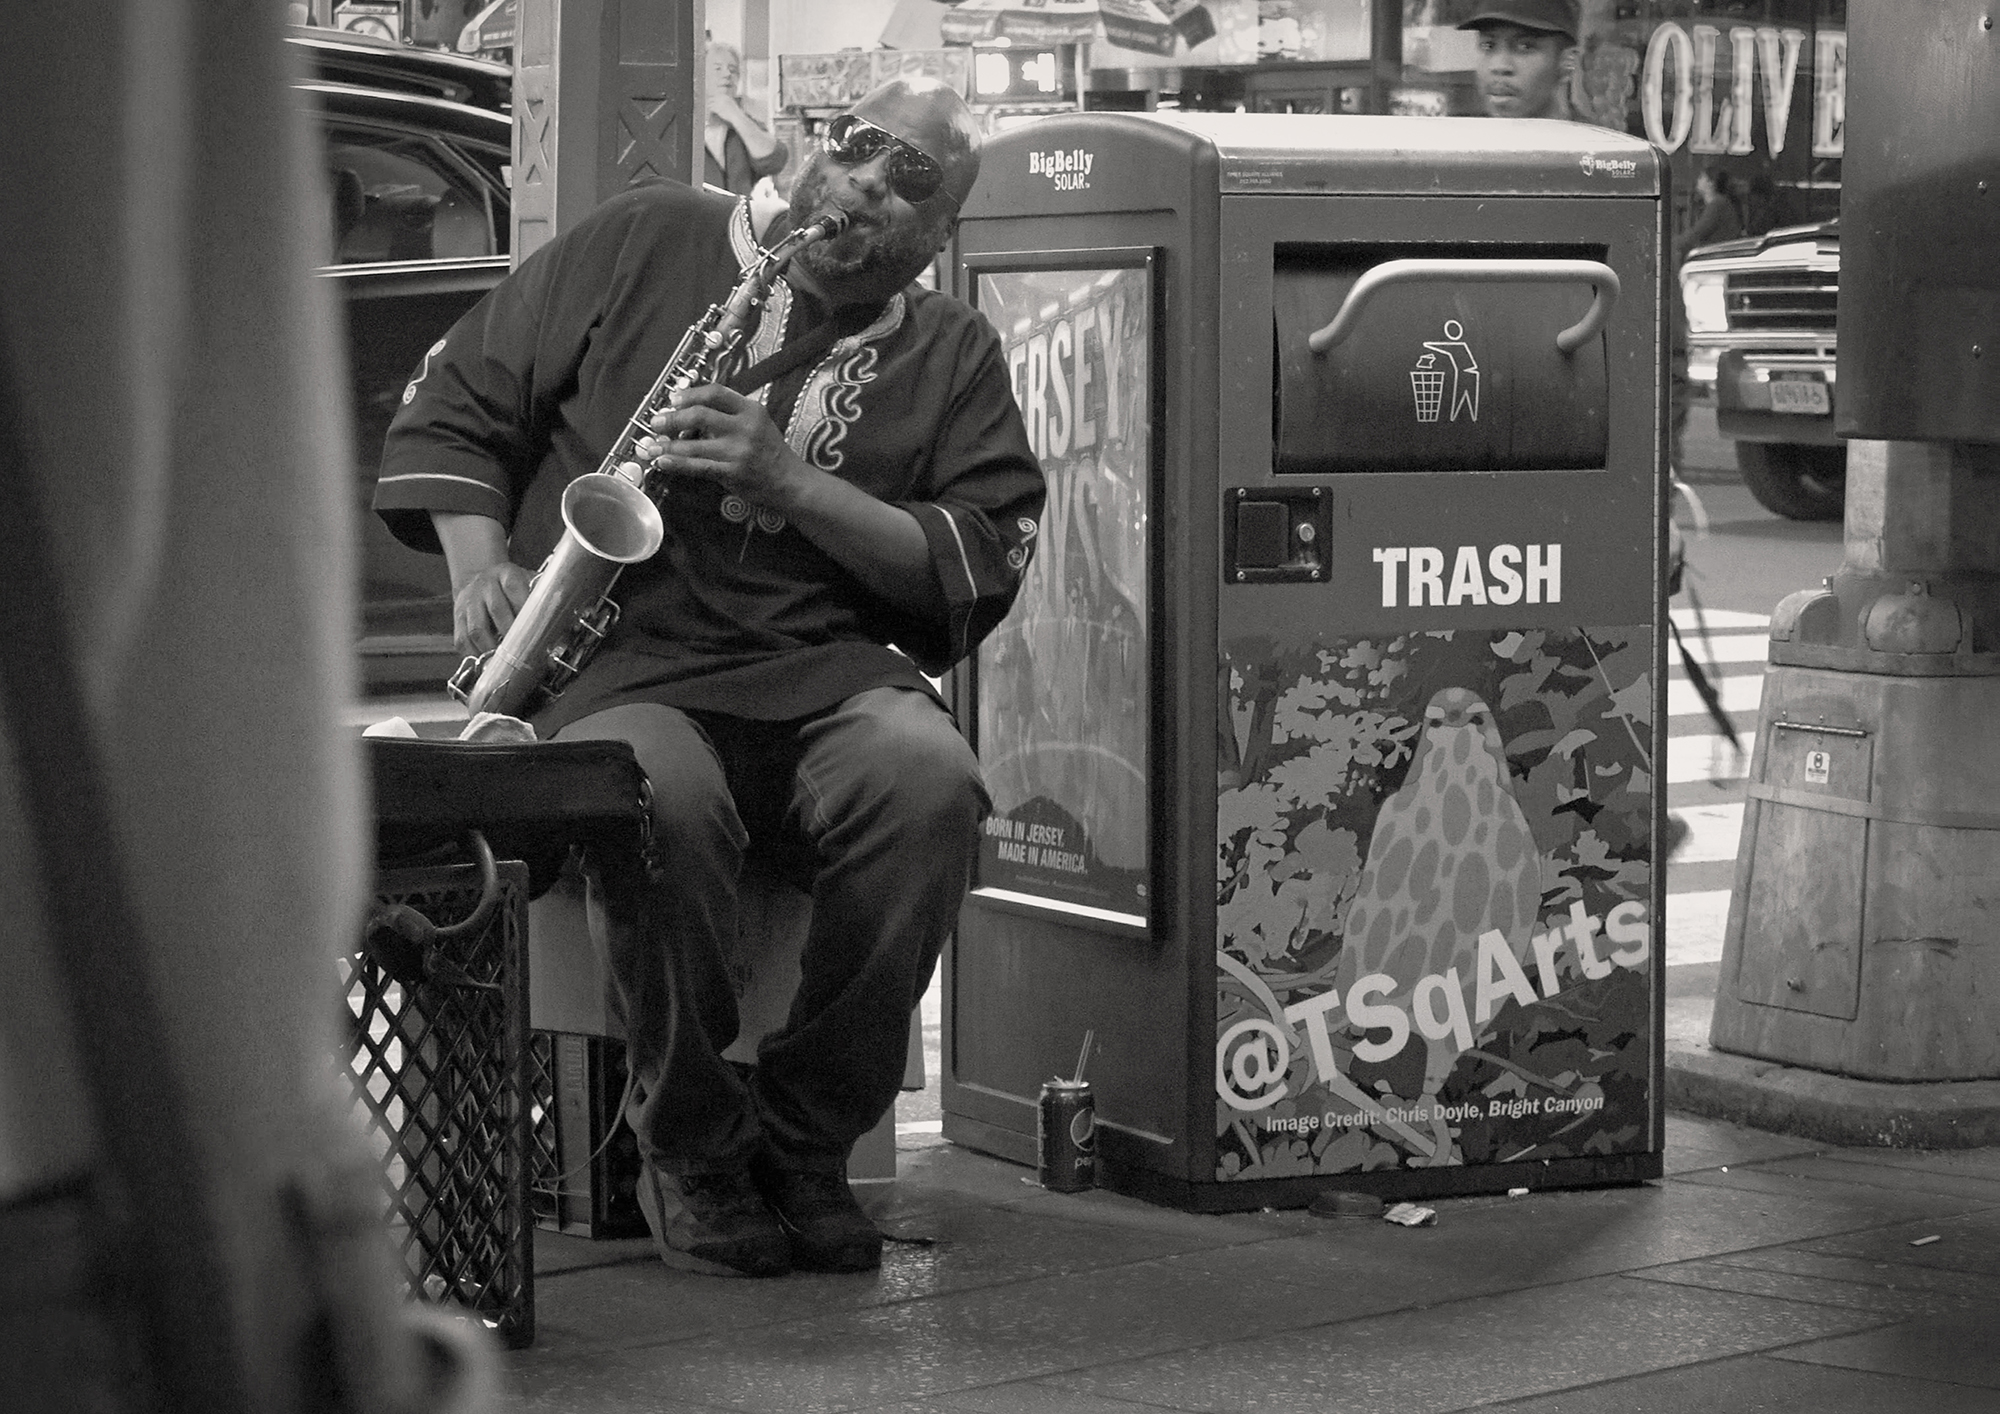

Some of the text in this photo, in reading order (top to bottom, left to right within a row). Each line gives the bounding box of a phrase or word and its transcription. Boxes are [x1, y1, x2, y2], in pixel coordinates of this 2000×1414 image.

[1641, 21, 1847, 159] OLIVE
[1028, 149, 1094, 178] BigBelly
[1595, 159, 1637, 171] BigBelly
[1372, 543, 1562, 608] TRASH
[986, 816, 1012, 839] BORN
[1014, 821, 1025, 841] IN
[998, 841, 1088, 875] MADE IN AMERICA.
[1216, 899, 1650, 1111] @TSqArts
[1266, 1096, 1605, 1134] Image Credit: Chris Doyle, Bright Canyon
